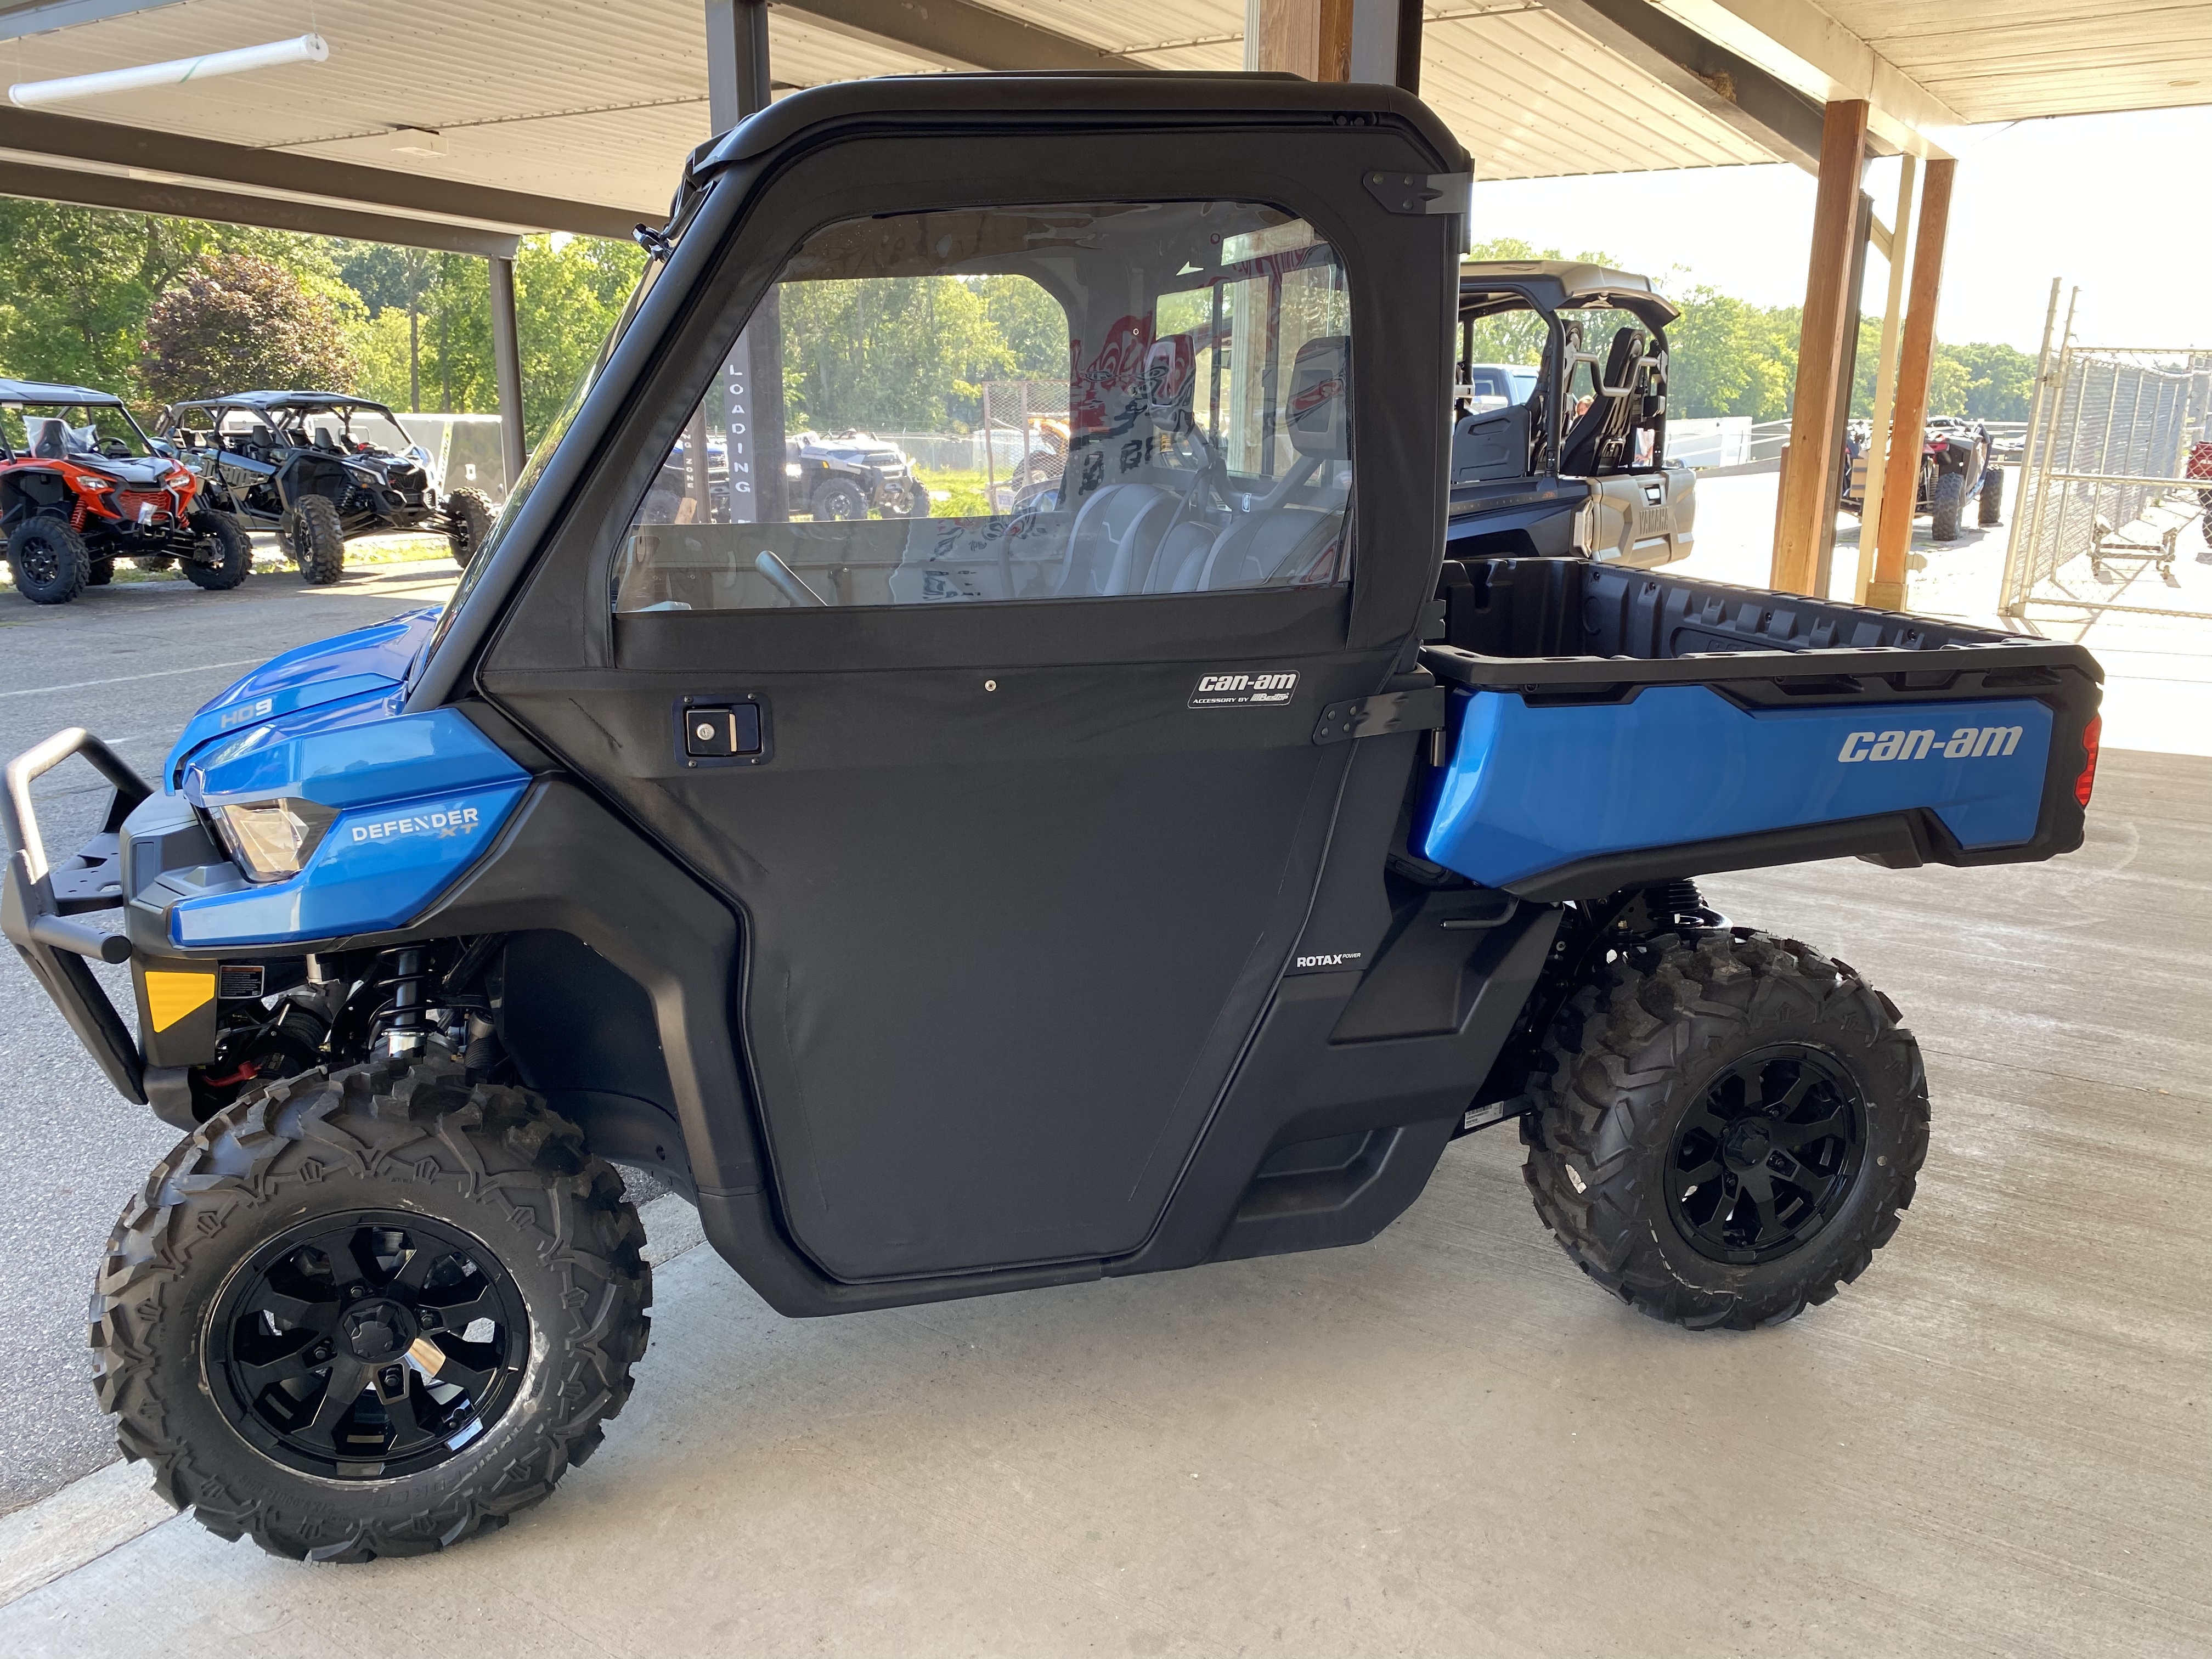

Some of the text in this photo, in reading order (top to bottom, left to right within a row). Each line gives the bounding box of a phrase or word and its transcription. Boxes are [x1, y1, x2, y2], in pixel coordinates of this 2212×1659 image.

[730, 364, 751, 493] LOADING
[1639, 506, 1668, 535] YAMAHA
[1198, 674, 1296, 692] can-am
[221, 698, 273, 729] HD9
[1838, 726, 2023, 763] can-am
[352, 808, 478, 842] DEFENDER
[439, 822, 478, 838] XT
[1297, 954, 1342, 967] ROTAX
